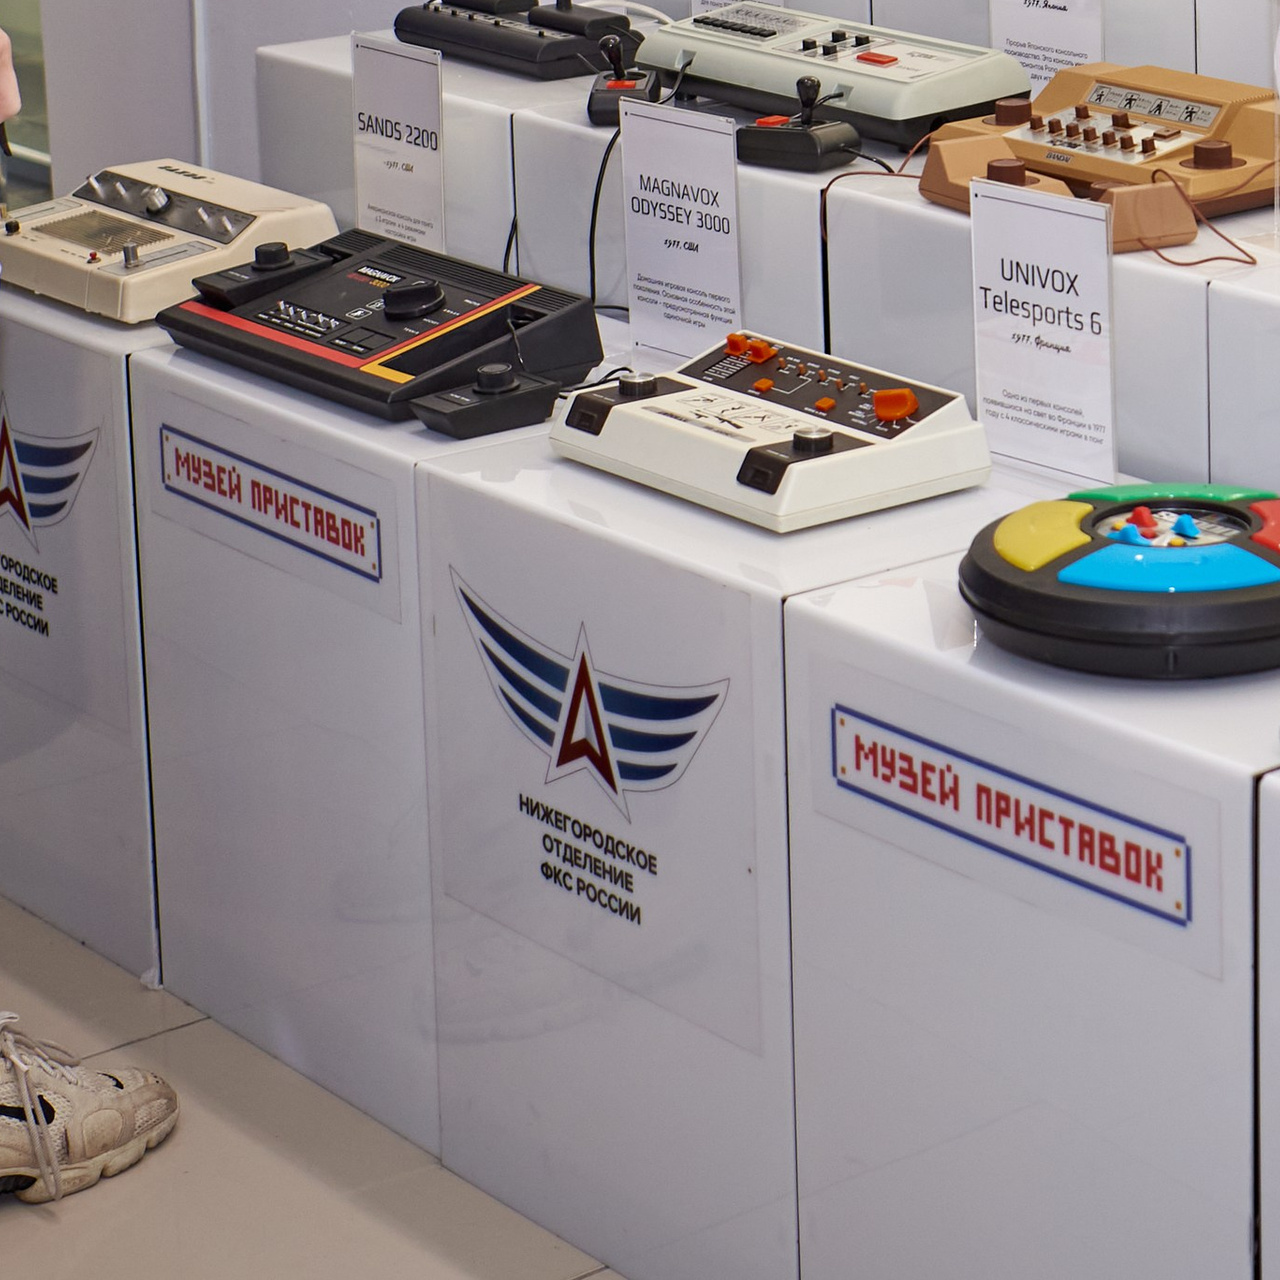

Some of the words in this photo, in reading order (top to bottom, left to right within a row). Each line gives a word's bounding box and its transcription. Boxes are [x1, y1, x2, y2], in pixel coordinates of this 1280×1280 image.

[358, 111, 402, 142] SANDS
[405, 124, 438, 151] 2200
[631, 196, 692, 225] ODYSSEY
[696, 210, 730, 235] 3000
[639, 174, 719, 208] MAGNAVOX
[1000, 258, 1079, 297] UNIVOX
[979, 286, 1084, 331] Telesports
[1090, 311, 1102, 336] 6
[174, 447, 241, 504] МУЗЕЙ
[251, 480, 365, 557] ПРИСТАВОК
[6, 602, 49, 637] РОССИИ
[519, 793, 658, 876] НИЖЕГОРОДСКОЕ
[855, 734, 959, 812] МУЗЕЙ
[976, 782, 1164, 893] ПРИСТАВОК
[542, 833, 634, 893] ОТДЕЛЕНИЕ
[540, 861, 573, 891] ФКС
[576, 877, 641, 925] РОССИИ
